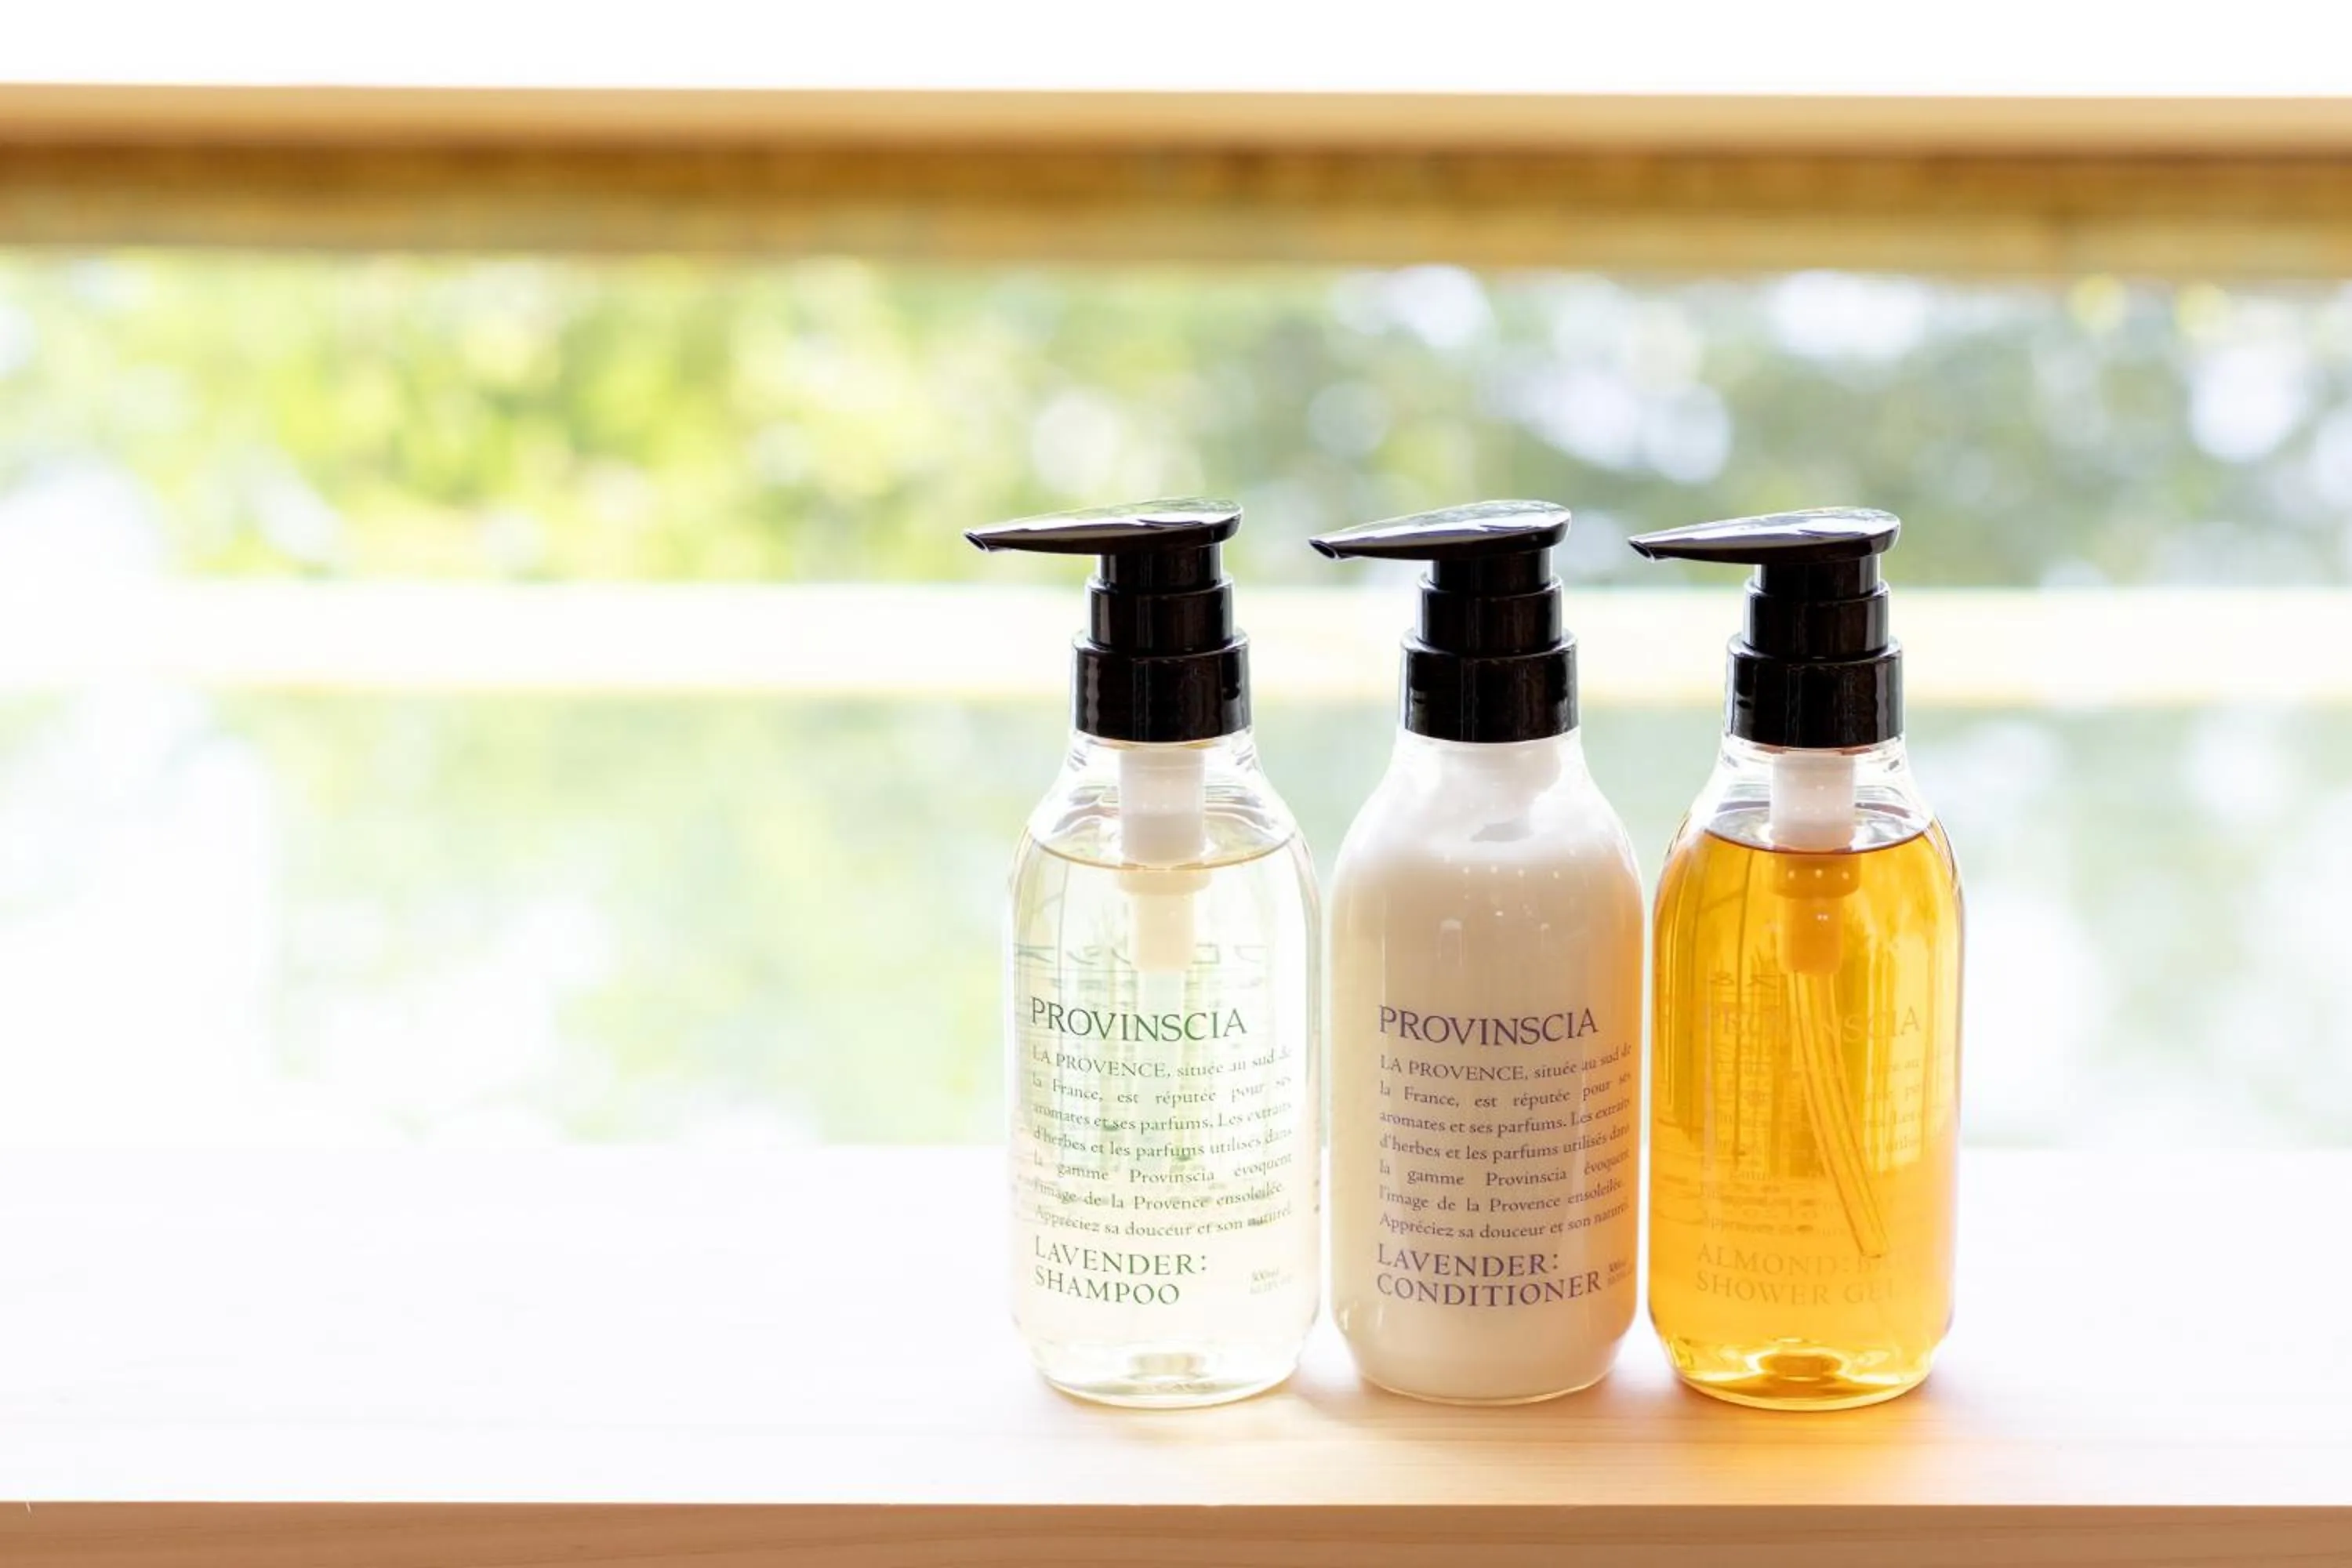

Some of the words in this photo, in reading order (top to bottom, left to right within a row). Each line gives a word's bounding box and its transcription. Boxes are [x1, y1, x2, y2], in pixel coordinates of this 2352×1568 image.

[1030, 996, 1247, 1043] PROVINSCIA
[1378, 1004, 1599, 1047] PROVINSCIA
[1033, 1044, 1051, 1065] LA
[1055, 1053, 1171, 1080] PROVENCE,
[1380, 1054, 1402, 1074] LA
[1408, 1061, 1529, 1082] PROVENCE,
[1534, 1062, 1577, 1079] située
[1052, 1077, 1104, 1102] France,
[1116, 1091, 1138, 1105] est
[1155, 1089, 1217, 1110] réputée
[1380, 1080, 1392, 1096] la
[1403, 1085, 1460, 1108] France,
[1474, 1095, 1497, 1109] est
[1512, 1089, 1571, 1111] réputée
[1582, 1080, 1612, 1102] pour
[1112, 1118, 1137, 1131] ses
[1218, 1112, 1244, 1127] Les
[1379, 1111, 1446, 1133] aromates
[1450, 1121, 1465, 1134] et
[1468, 1122, 1494, 1134] ses
[1497, 1118, 1566, 1138] parfums.
[1570, 1110, 1593, 1127] Les
[1091, 1142, 1105, 1155] et
[1109, 1139, 1131, 1156] les
[1135, 1142, 1205, 1161] parfums
[1379, 1132, 1441, 1160] d'herbes
[1445, 1146, 1461, 1160] et
[1466, 1144, 1488, 1161] les
[1492, 1143, 1559, 1164] parfums
[1563, 1132, 1607, 1153] utilisés
[1056, 1163, 1109, 1181] gamme
[1129, 1167, 1214, 1185] Provinscia
[1379, 1158, 1391, 1175] la
[1406, 1167, 1465, 1187] gamme
[1486, 1167, 1568, 1186] Provinscia
[1083, 1190, 1102, 1207] de
[1111, 1192, 1124, 1208] la
[1134, 1195, 1209, 1210] Provence
[1378, 1183, 1429, 1212] l'image
[1436, 1196, 1456, 1212] de
[1466, 1196, 1480, 1213] la
[1489, 1196, 1561, 1213] Provence
[1105, 1223, 1120, 1235] sa
[1124, 1221, 1192, 1237] douceur
[1197, 1221, 1211, 1236] et
[1216, 1220, 1243, 1233] son
[1379, 1211, 1454, 1239] Appréciez
[1457, 1225, 1474, 1239] sa
[1479, 1222, 1547, 1240] douceur
[1549, 1221, 1564, 1235] et
[1566, 1217, 1592, 1230] son
[1034, 1235, 1207, 1276] LAVENDER:
[1377, 1242, 1559, 1278] LAVENDER:
[1033, 1264, 1181, 1305] SHAMPOO
[1377, 1269, 1602, 1308] CONDITIONER
[1695, 1269, 1831, 1306] SHOWER
